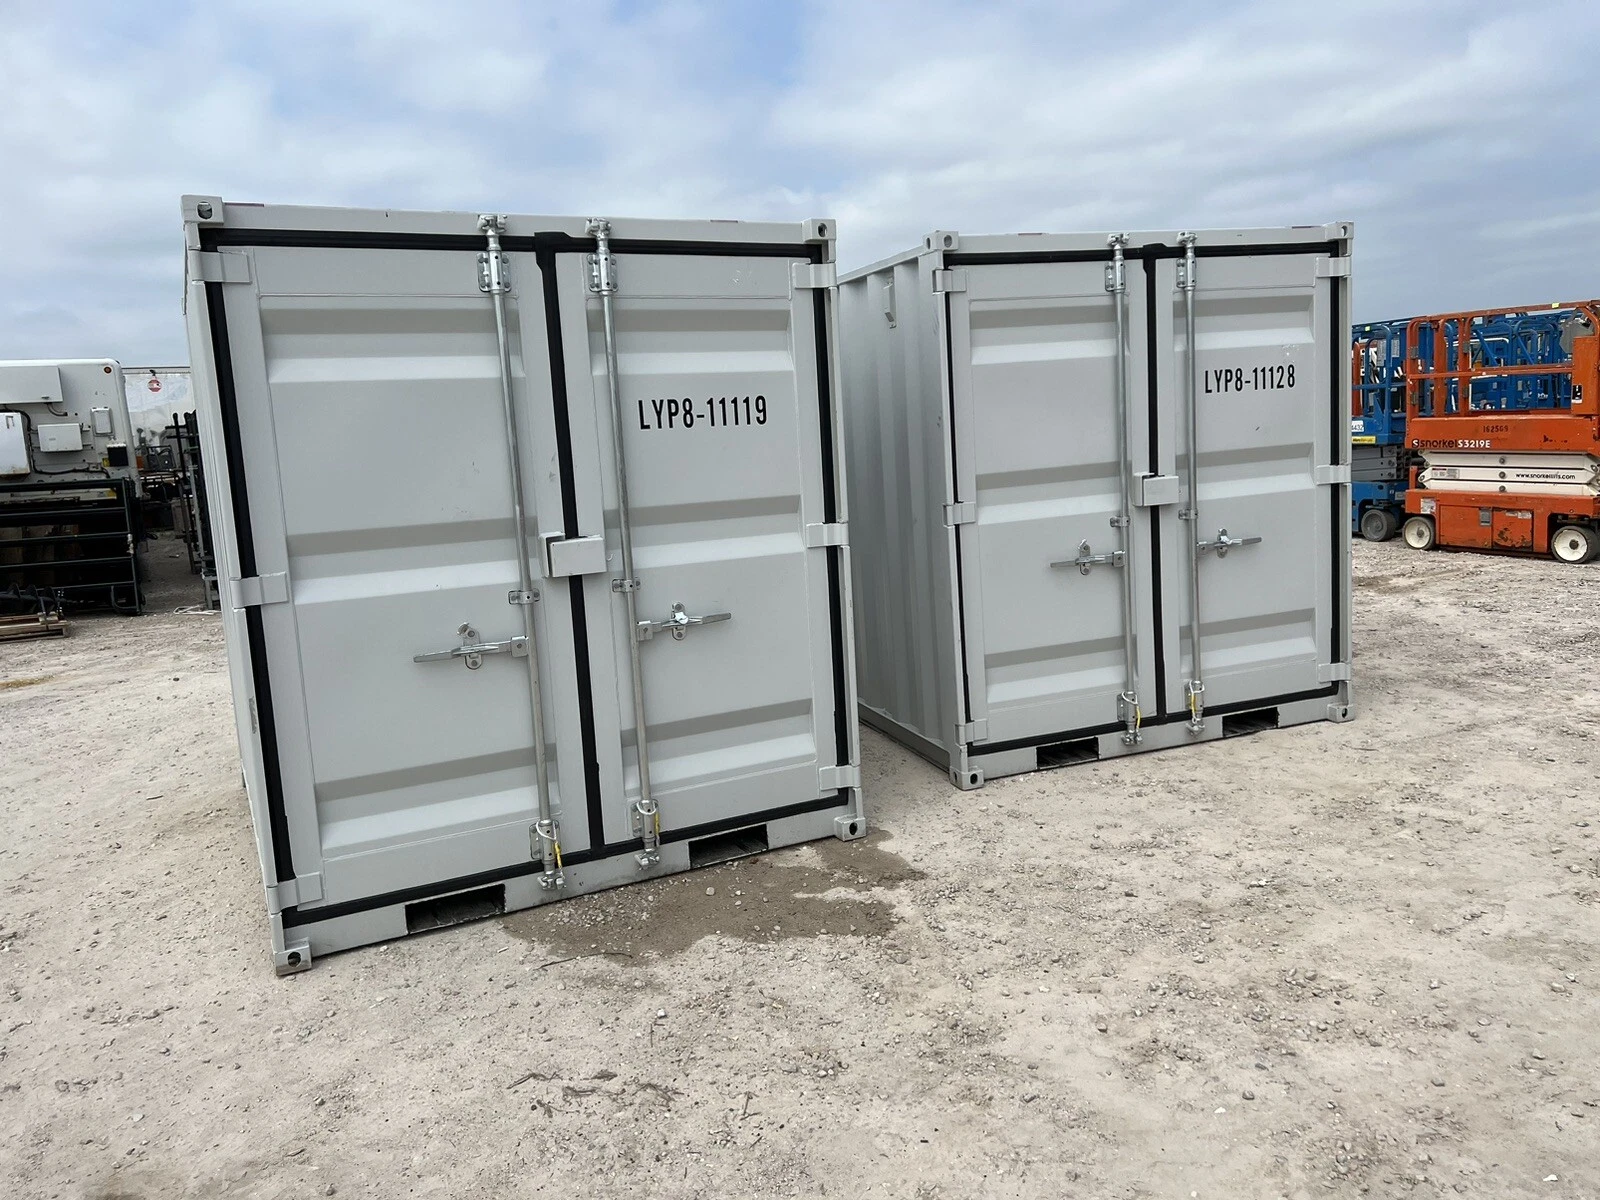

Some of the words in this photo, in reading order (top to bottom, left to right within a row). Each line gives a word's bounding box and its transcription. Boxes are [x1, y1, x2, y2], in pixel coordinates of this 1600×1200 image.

[1205, 364, 1295, 393] LYP8-11128
[638, 395, 767, 430] LYP8-11119
[1420, 439, 1458, 449] snorkel
